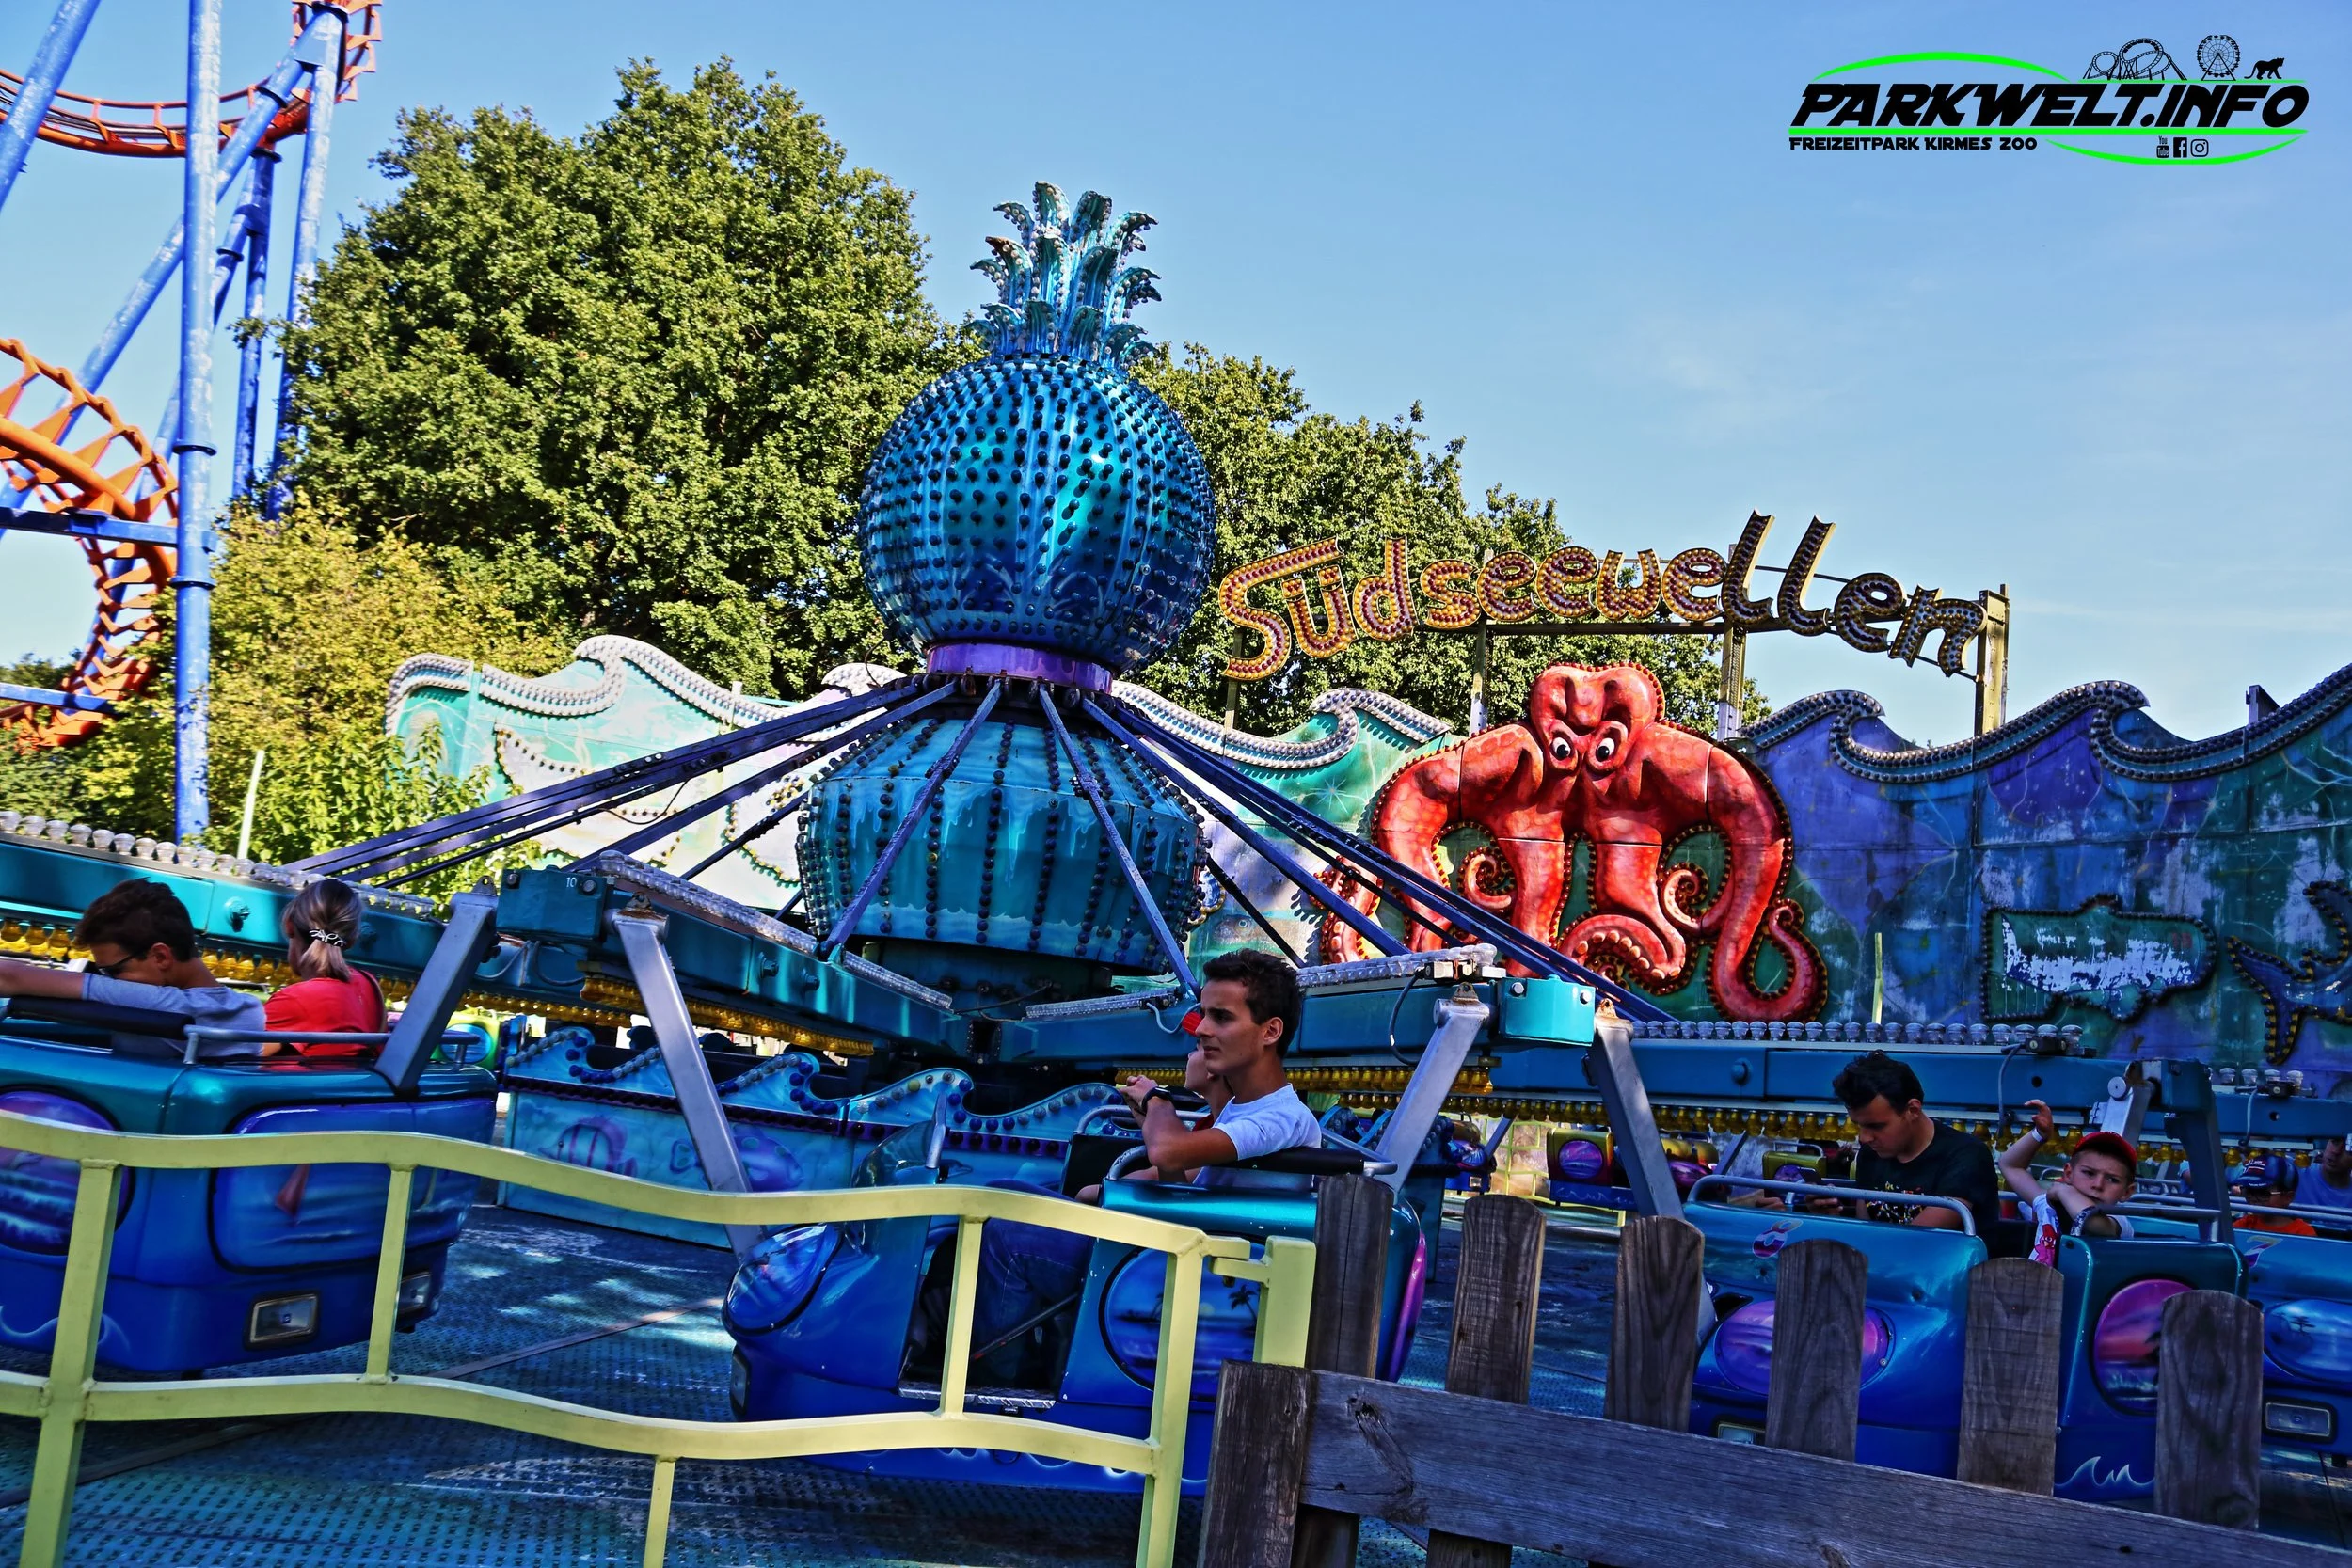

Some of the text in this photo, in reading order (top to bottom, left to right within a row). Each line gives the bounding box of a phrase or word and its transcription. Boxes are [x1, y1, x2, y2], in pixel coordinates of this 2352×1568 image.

[1218, 508, 1988, 677] Südseewellen
[565, 877, 578, 888] 10
[1753, 1218, 1804, 1259] 8
